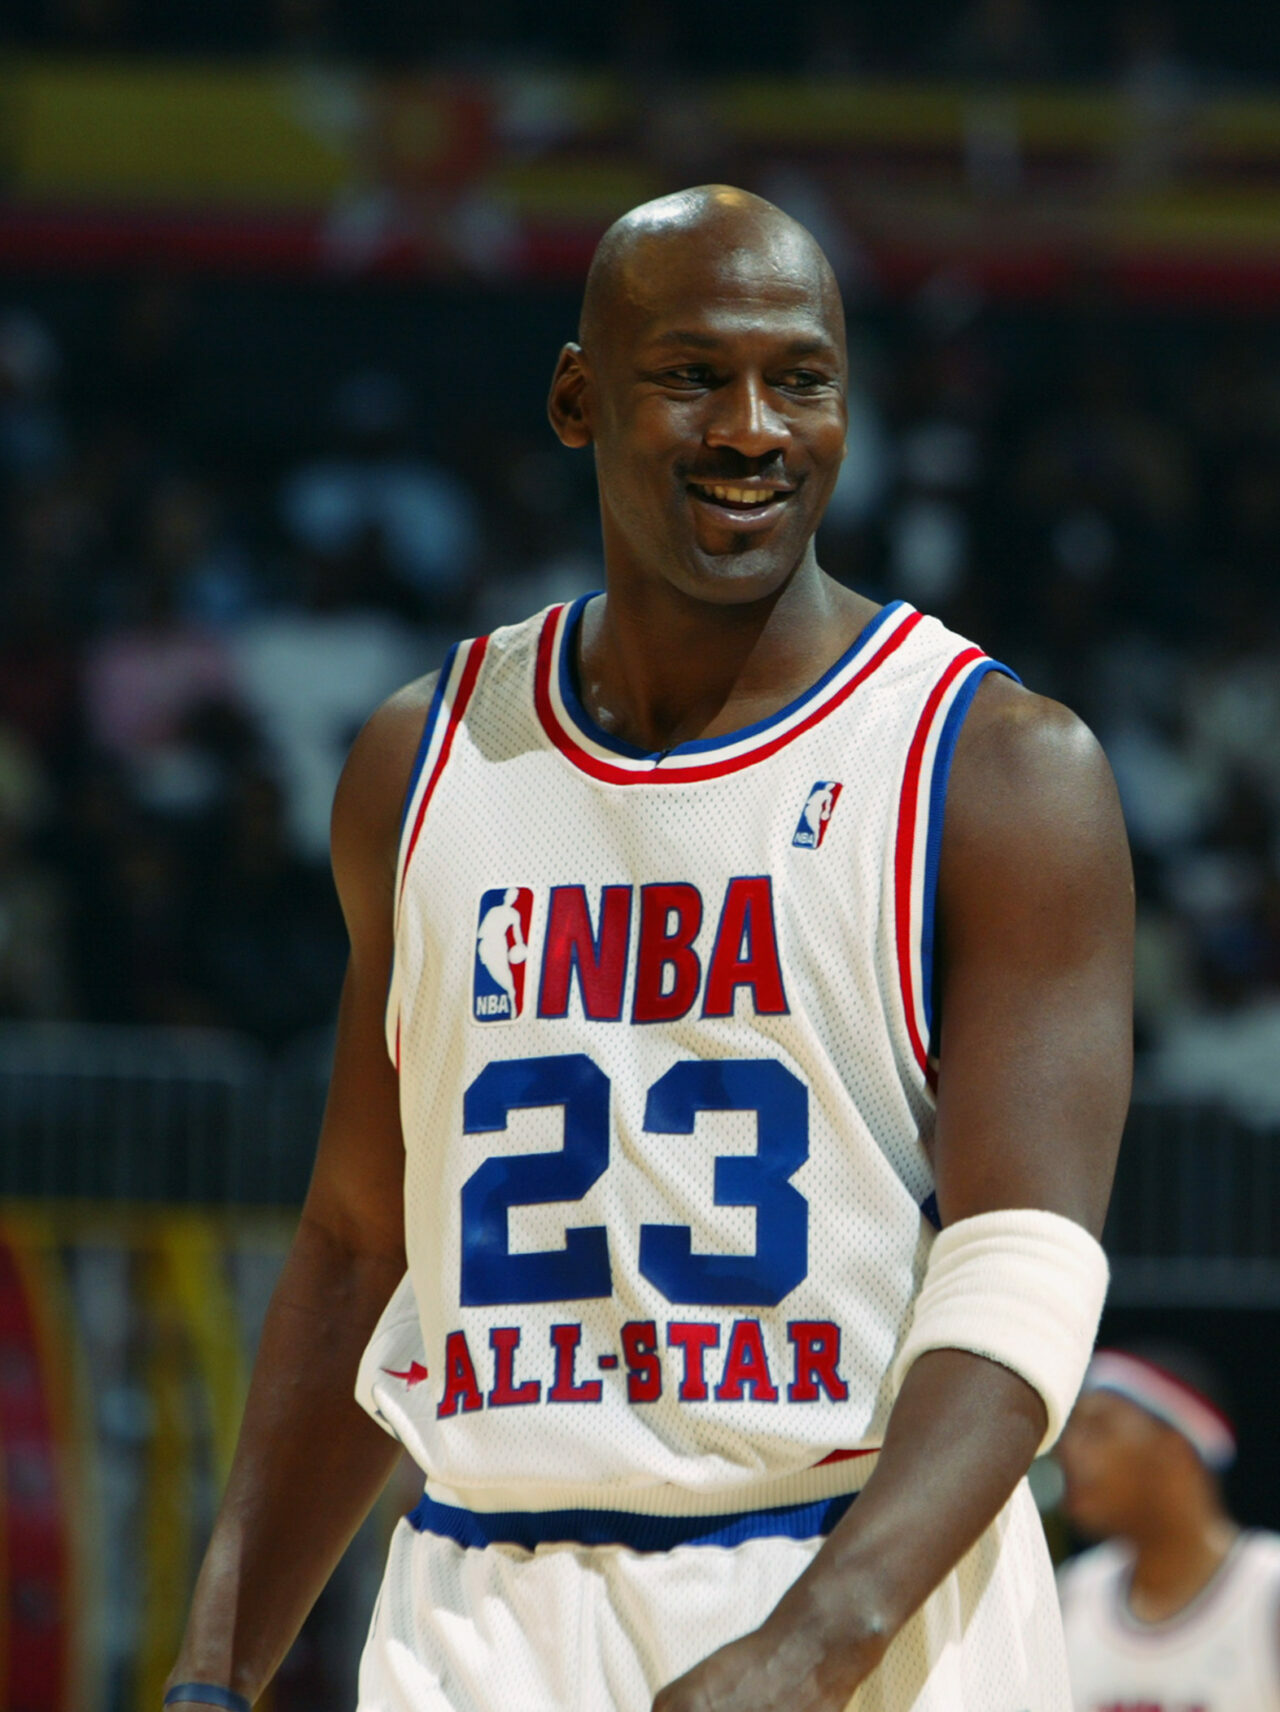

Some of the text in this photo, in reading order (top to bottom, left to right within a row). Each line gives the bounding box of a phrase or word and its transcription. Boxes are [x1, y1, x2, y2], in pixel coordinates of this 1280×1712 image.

[794, 832, 814, 844] NBA
[536, 875, 790, 1024] NBA
[476, 994, 510, 1016] NBA
[459, 1053, 809, 1308] 23
[437, 1318, 849, 1420] ALL-STAR
